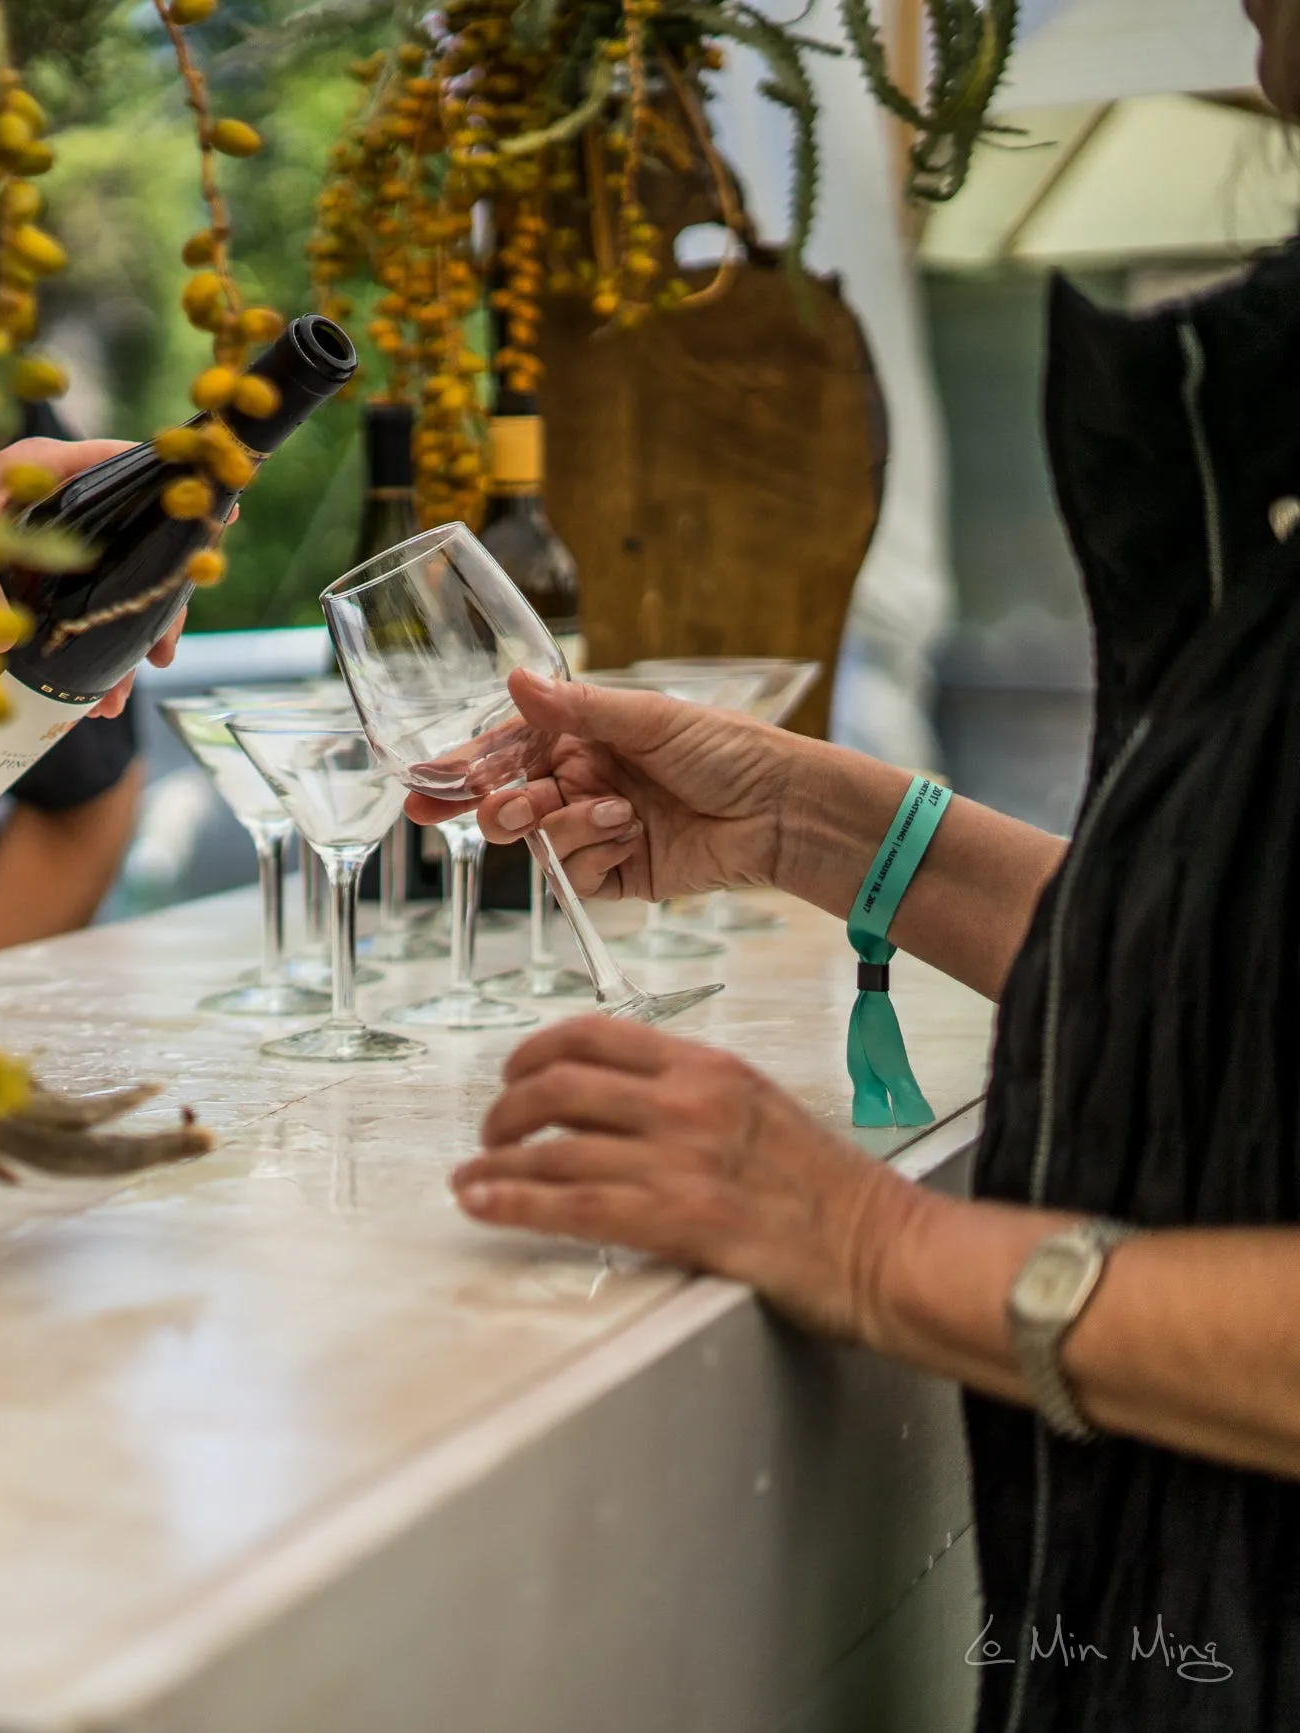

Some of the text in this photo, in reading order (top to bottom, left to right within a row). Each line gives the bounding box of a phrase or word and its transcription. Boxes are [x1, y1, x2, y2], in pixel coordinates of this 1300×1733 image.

[918, 778, 931, 797] ORTS
[927, 785, 944, 807] 2017
[896, 796, 924, 842] GATHERING
[878, 847, 898, 881] AUGUST
